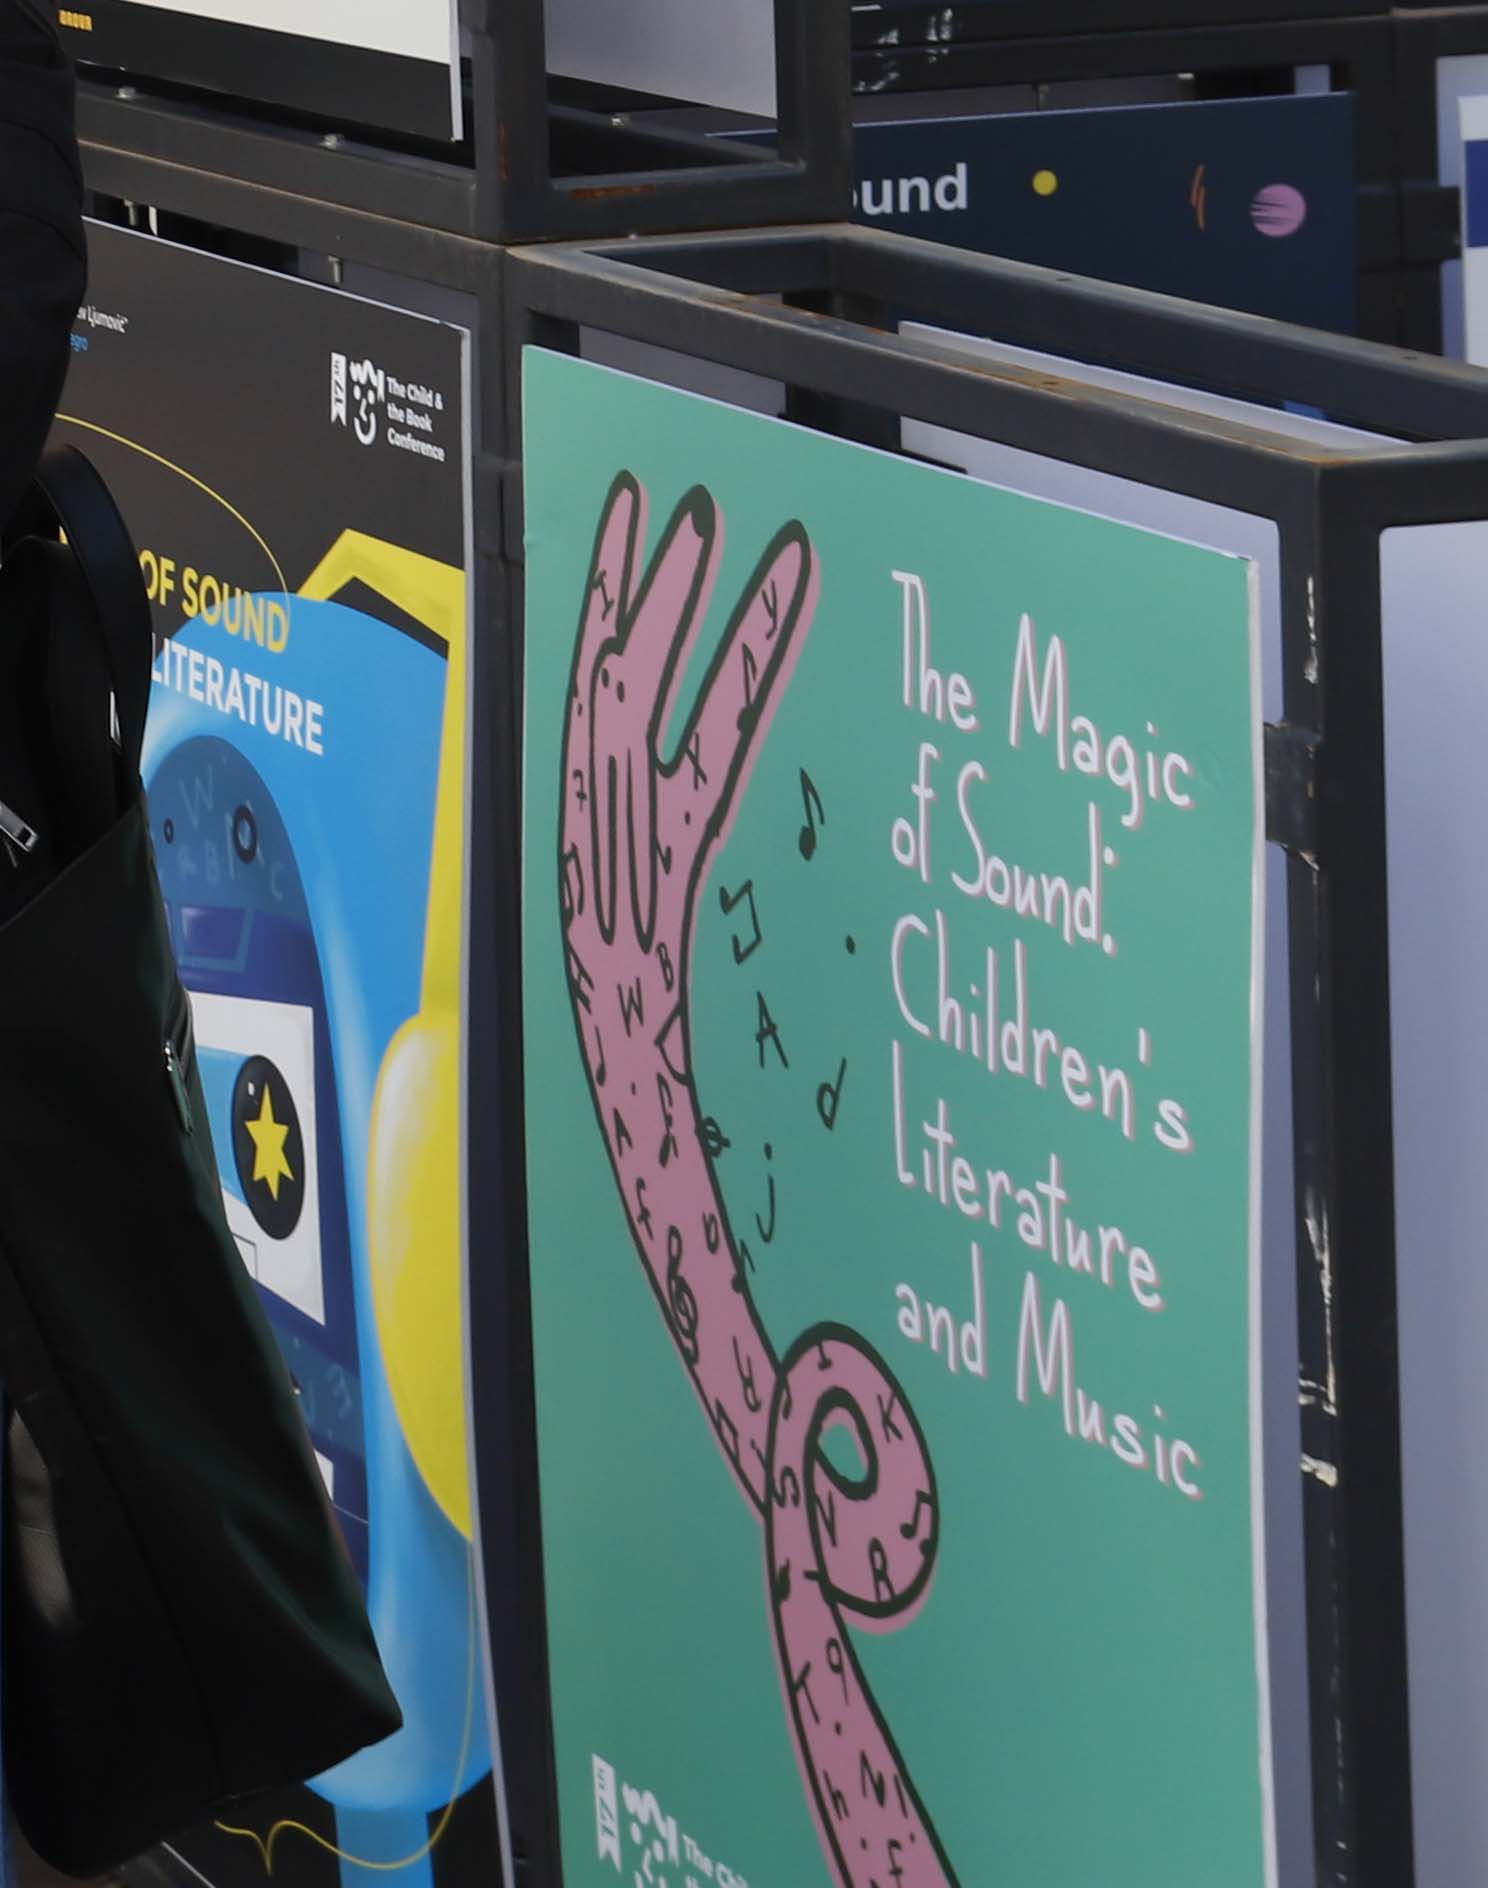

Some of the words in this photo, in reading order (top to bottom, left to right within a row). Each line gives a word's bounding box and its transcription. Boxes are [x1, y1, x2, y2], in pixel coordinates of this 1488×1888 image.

[853, 163, 967, 215] und
[386, 377, 406, 398] The
[407, 383, 433, 407] Child
[387, 403, 405, 423] the
[406, 408, 432, 432] Book
[387, 427, 445, 462] Conference
[139, 548, 175, 605] OF
[181, 567, 289, 655] SOUND
[151, 633, 324, 756] LITERATURE
[891, 568, 978, 729] The
[1009, 613, 1195, 828] Magic
[891, 741, 936, 881] of
[891, 911, 1193, 1152] Children's
[893, 1040, 1164, 1310] Literature
[893, 1241, 986, 1376] and
[1016, 1272, 1203, 1499] Music
[682, 1834, 713, 1878] The
